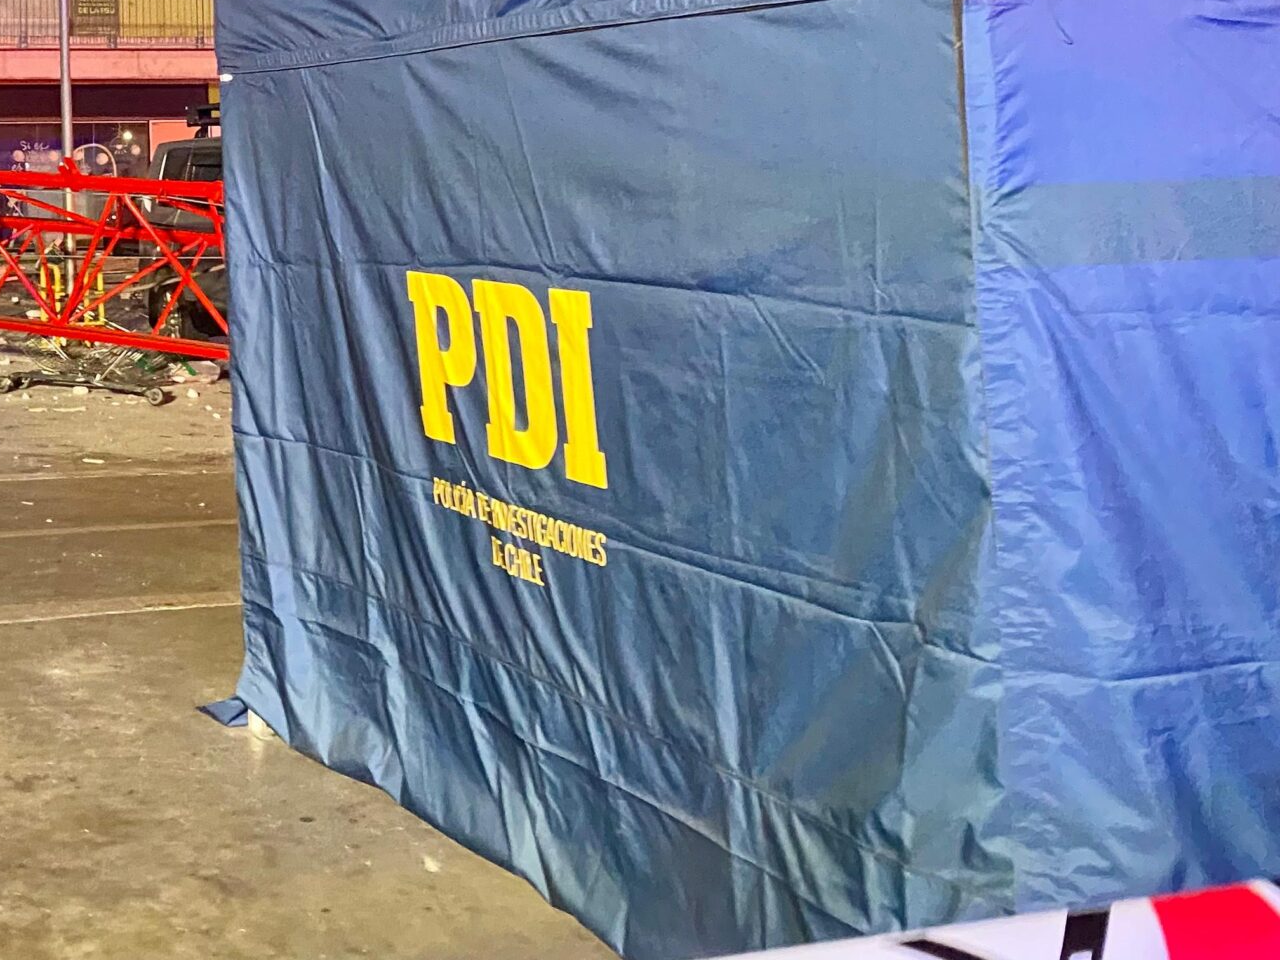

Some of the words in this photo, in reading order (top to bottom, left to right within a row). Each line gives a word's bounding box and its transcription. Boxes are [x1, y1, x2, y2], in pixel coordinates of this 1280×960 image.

[406, 270, 608, 489] PDI
[433, 477, 477, 518] POLICÍA
[491, 497, 608, 567] INVESTIGACIONES
[504, 543, 545, 587] CHILE
